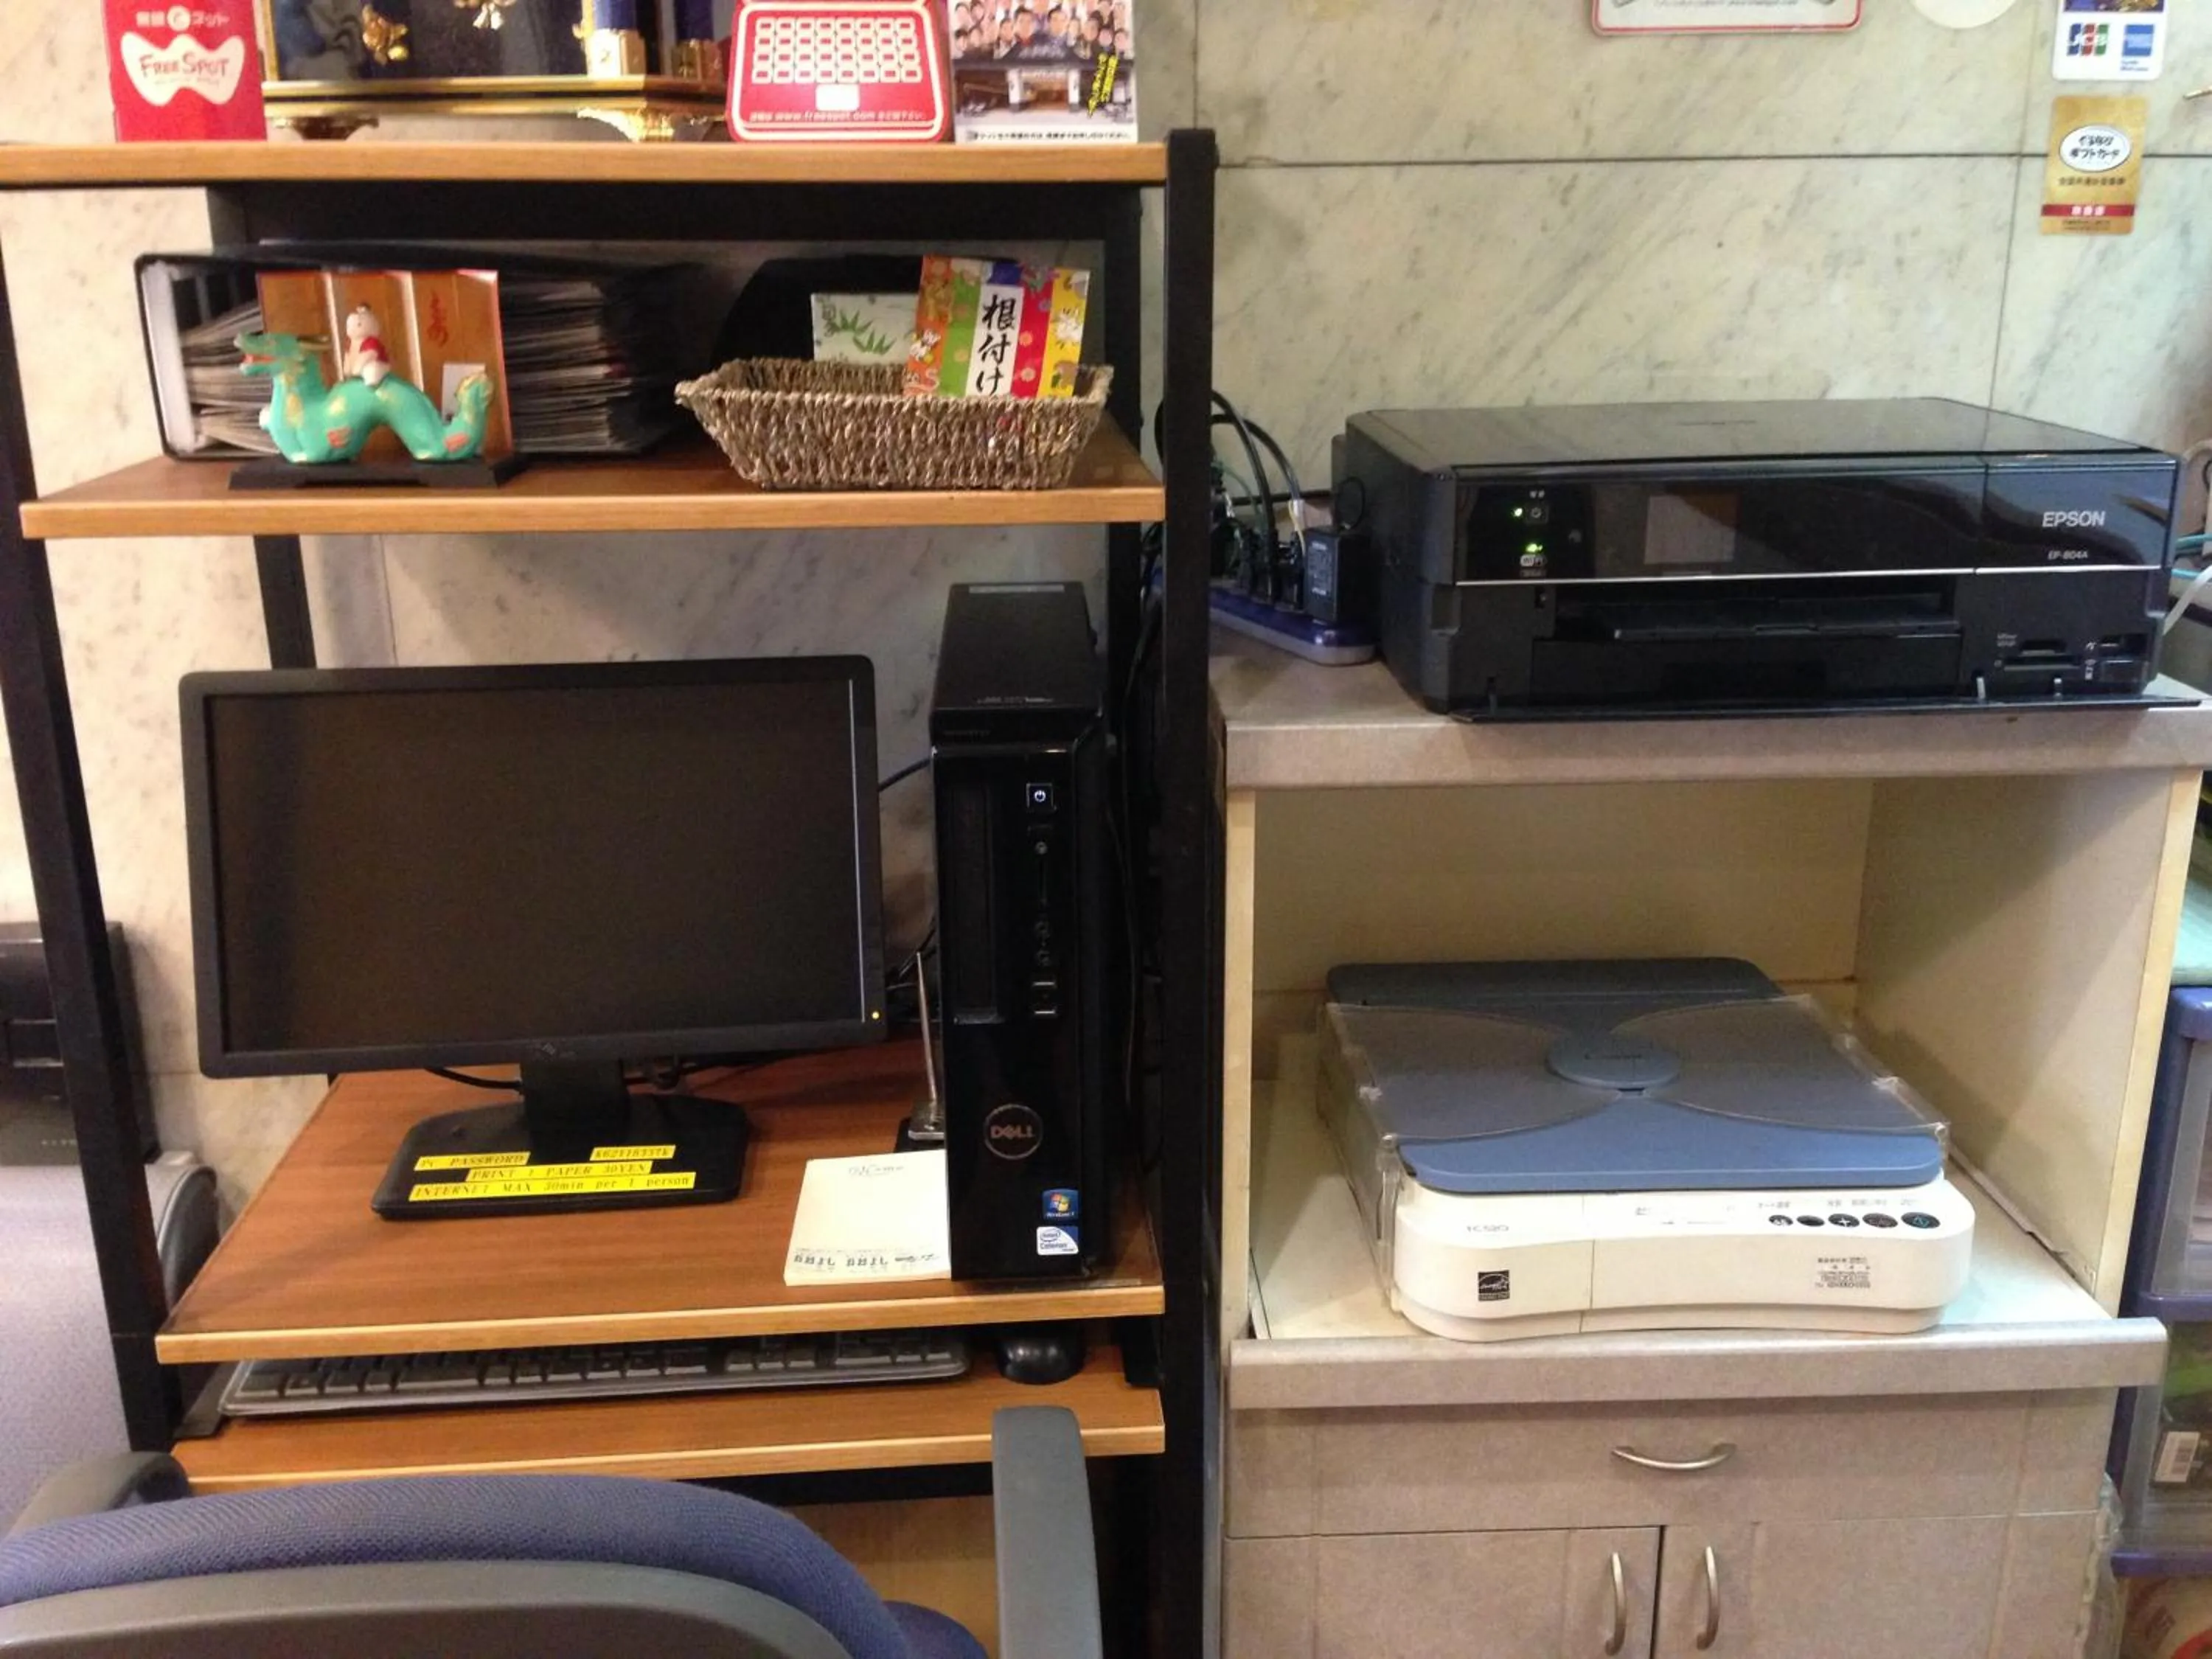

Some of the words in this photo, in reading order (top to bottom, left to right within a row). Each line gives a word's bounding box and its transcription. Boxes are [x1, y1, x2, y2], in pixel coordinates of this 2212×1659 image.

[975, 293, 1016, 396] 根付け
[2042, 511, 2105, 527] EPSON
[990, 1125, 1035, 1139] DELL
[450, 1155, 525, 1167] PASSWORD
[472, 1169, 516, 1179] PRINT
[546, 1166, 591, 1176] PAPER
[415, 1184, 490, 1197] INTERNET
[503, 1183, 531, 1192] MAX
[595, 1179, 616, 1189] per
[646, 1177, 690, 1187] person
